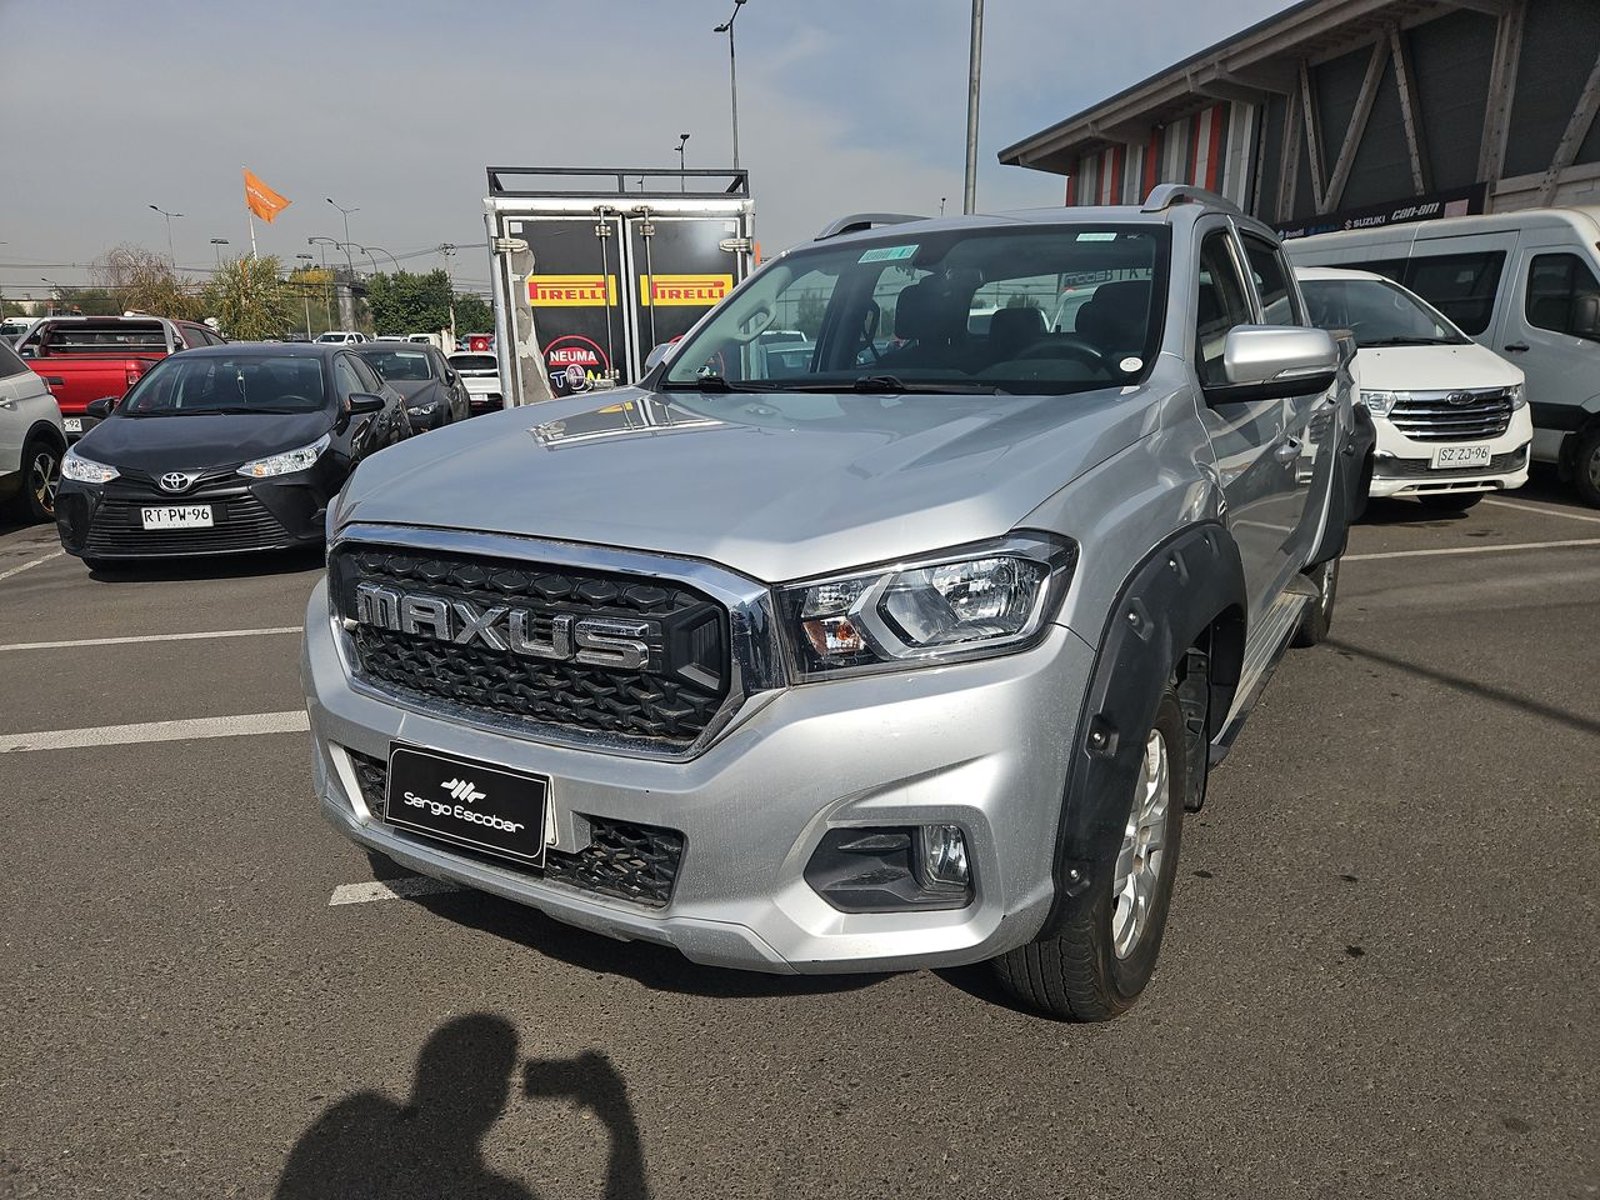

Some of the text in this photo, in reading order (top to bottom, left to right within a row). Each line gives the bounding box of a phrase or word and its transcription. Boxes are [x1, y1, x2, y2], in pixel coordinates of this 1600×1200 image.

[1353, 215, 1386, 228] SUZUKI
[652, 281, 725, 299] PIRELLI
[549, 350, 597, 362] NEUMA
[356, 583, 650, 670] MAXUS
[403, 791, 525, 834] Sergo Escobar
